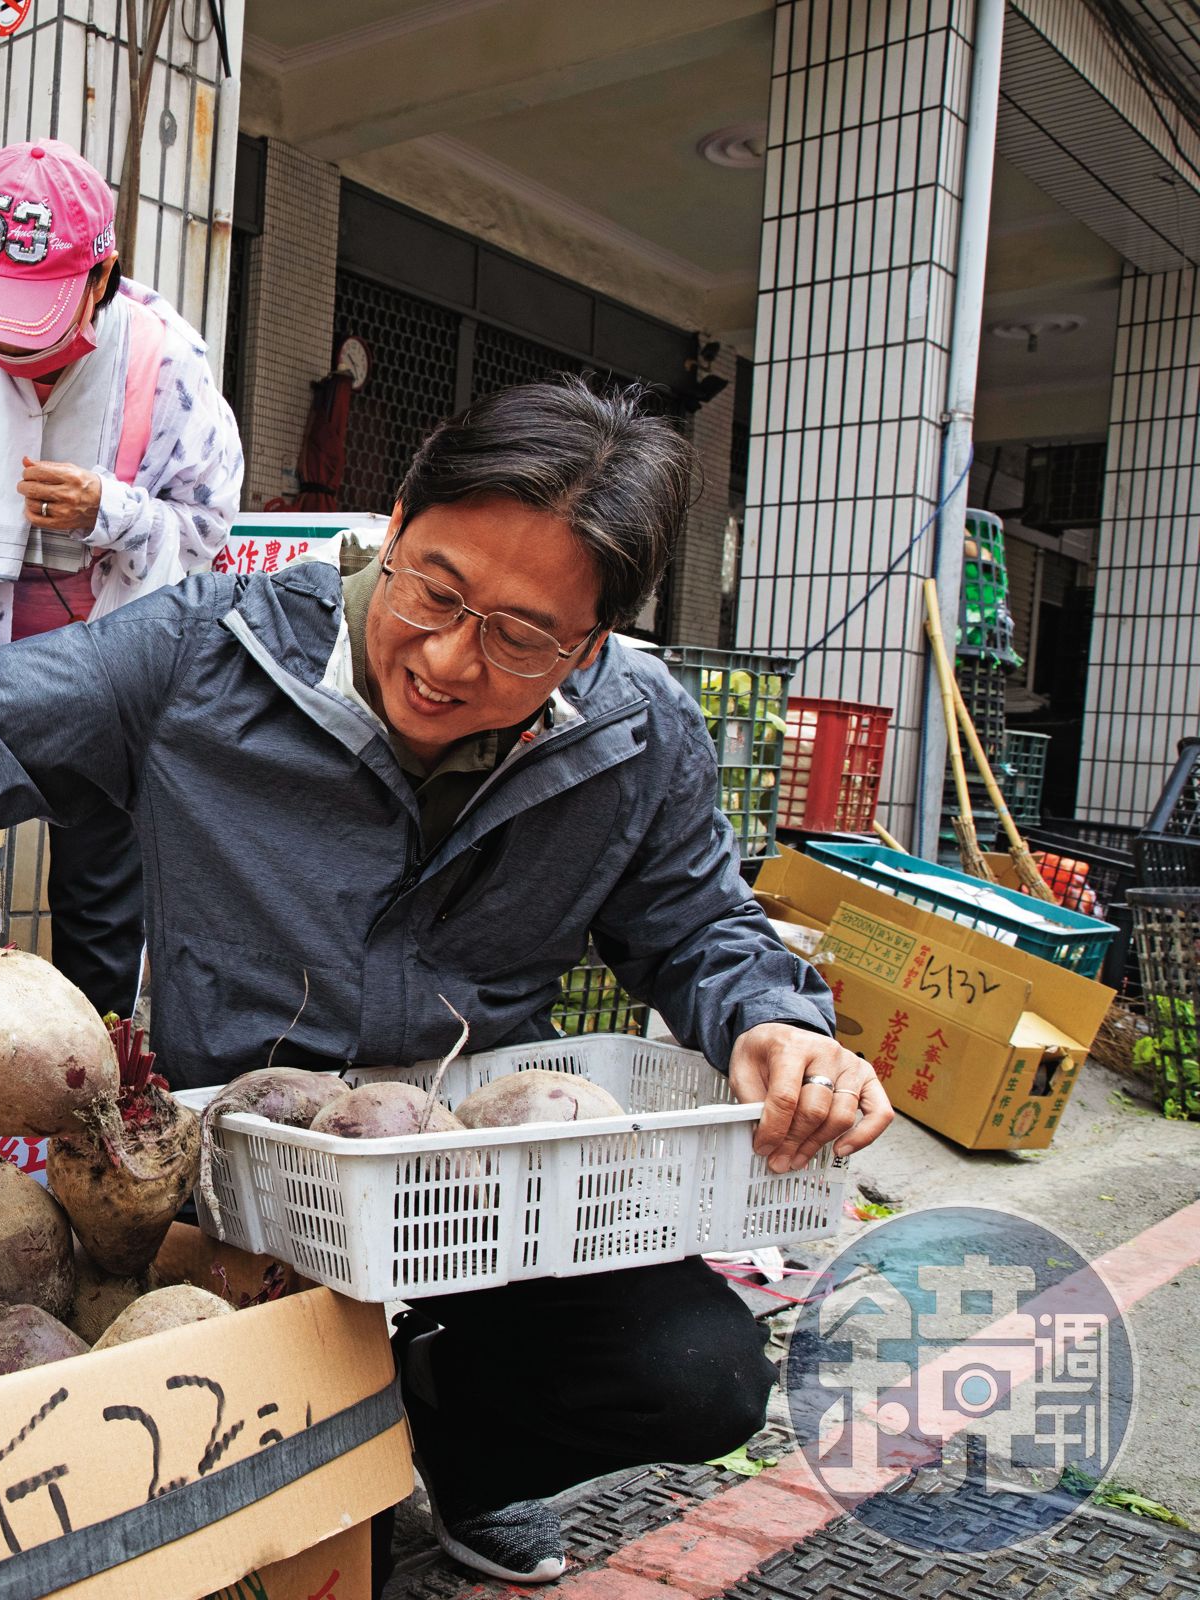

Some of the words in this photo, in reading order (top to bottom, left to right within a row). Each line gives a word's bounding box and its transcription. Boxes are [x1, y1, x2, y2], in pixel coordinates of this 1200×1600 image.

[920, 955, 1001, 1004] 5132
[872, 1009, 910, 1083] 芳苑鄉
